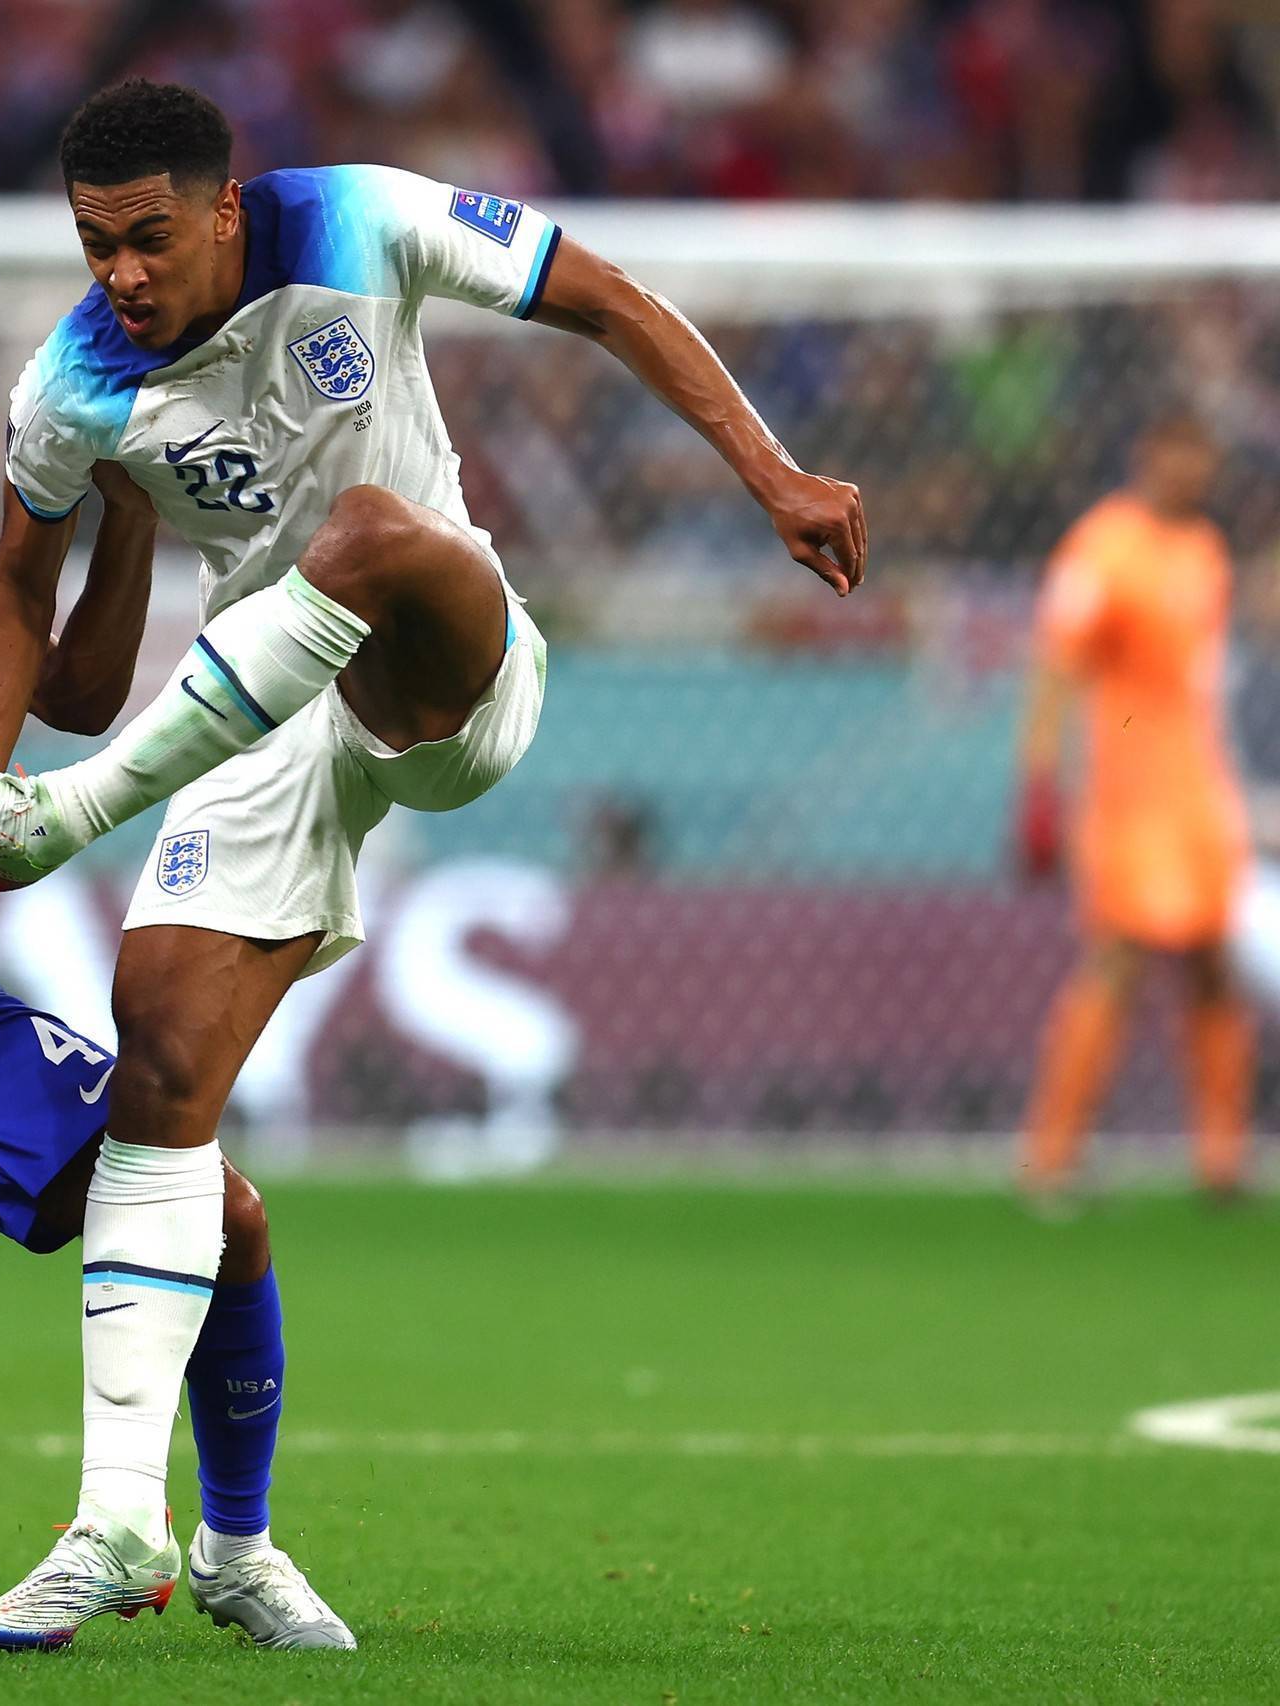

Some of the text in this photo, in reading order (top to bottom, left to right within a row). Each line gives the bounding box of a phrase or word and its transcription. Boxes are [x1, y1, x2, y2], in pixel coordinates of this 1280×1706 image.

[354, 400, 373, 416] USA
[173, 450, 275, 513] 22
[30, 1016, 107, 1066] 4
[226, 1378, 276, 1393] USA
